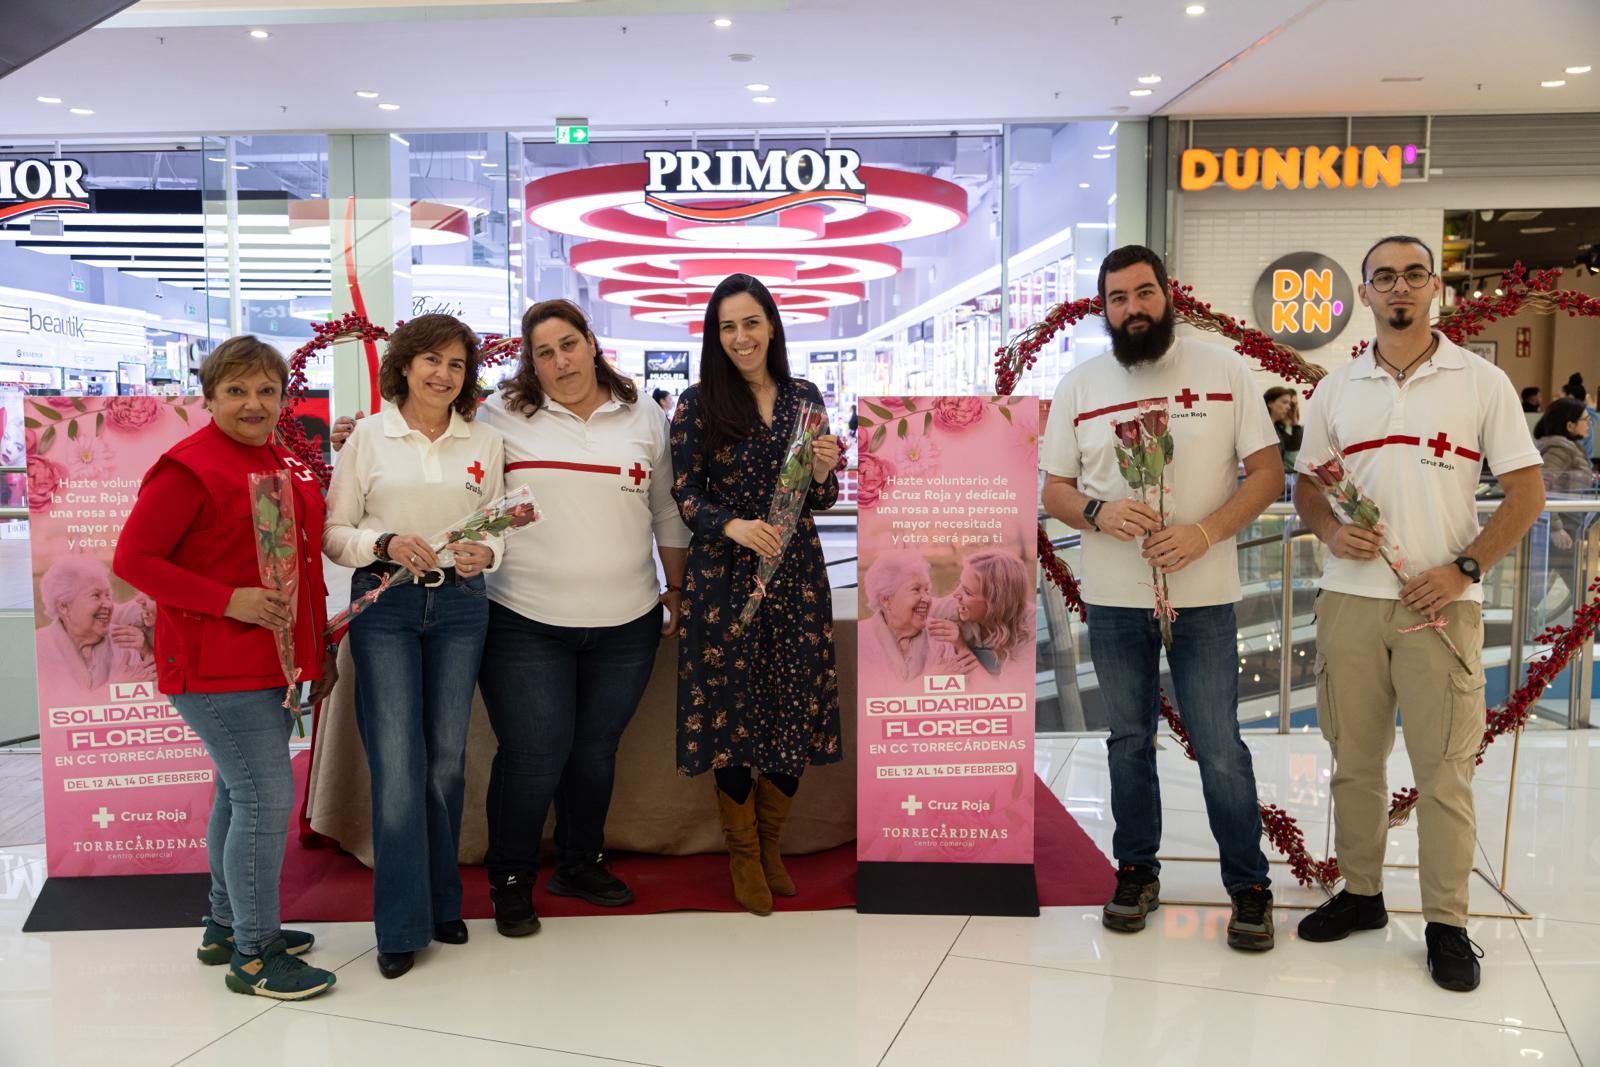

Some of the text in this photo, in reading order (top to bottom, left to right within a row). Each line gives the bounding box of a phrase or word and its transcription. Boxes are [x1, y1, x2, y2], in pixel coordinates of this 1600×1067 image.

[645, 149, 865, 191] PRIMOR
[1180, 144, 1417, 190] DUNKIN'
[1273, 269, 1333, 301] DN
[29, 307, 85, 338] beautik
[1420, 458, 1455, 470] Cruz Roja
[59, 477, 142, 489] Hazte volunt
[887, 475, 1008, 486] Hazte voluntario de
[50, 492, 62, 503] la
[65, 493, 97, 503] Cruz
[100, 492, 129, 505] Roja
[878, 489, 1017, 502] la Cruz Roja y dedícale
[49, 510, 73, 518] una
[77, 510, 105, 518] rosa
[877, 506, 1018, 517] una rosa a una persona
[67, 524, 108, 535] mayor
[892, 518, 1002, 531] mayor necesitada
[68, 540, 75, 550] y
[79, 538, 107, 547] otra
[892, 532, 1002, 545] y otra será para ti
[929, 676, 961, 690] LA
[115, 684, 149, 699] LA
[869, 696, 1023, 714] SOLIDARIDAD
[53, 704, 182, 725] SOLIDARID
[886, 718, 1008, 737] FLORECE
[71, 726, 201, 748] FLORECE
[870, 739, 1026, 754] EN CC TORRECÁRDENAS
[55, 747, 210, 767] EN CC TORRECÁRDENA
[879, 764, 1014, 777] DEL 12 AL 14 DE FEBRERO
[67, 772, 210, 790] DEL 12 AL 14 DE FEBRERO
[927, 799, 990, 813] Cruz Roja
[120, 808, 188, 823] Cruz Roja
[107, 851, 173, 860] centro comercial
